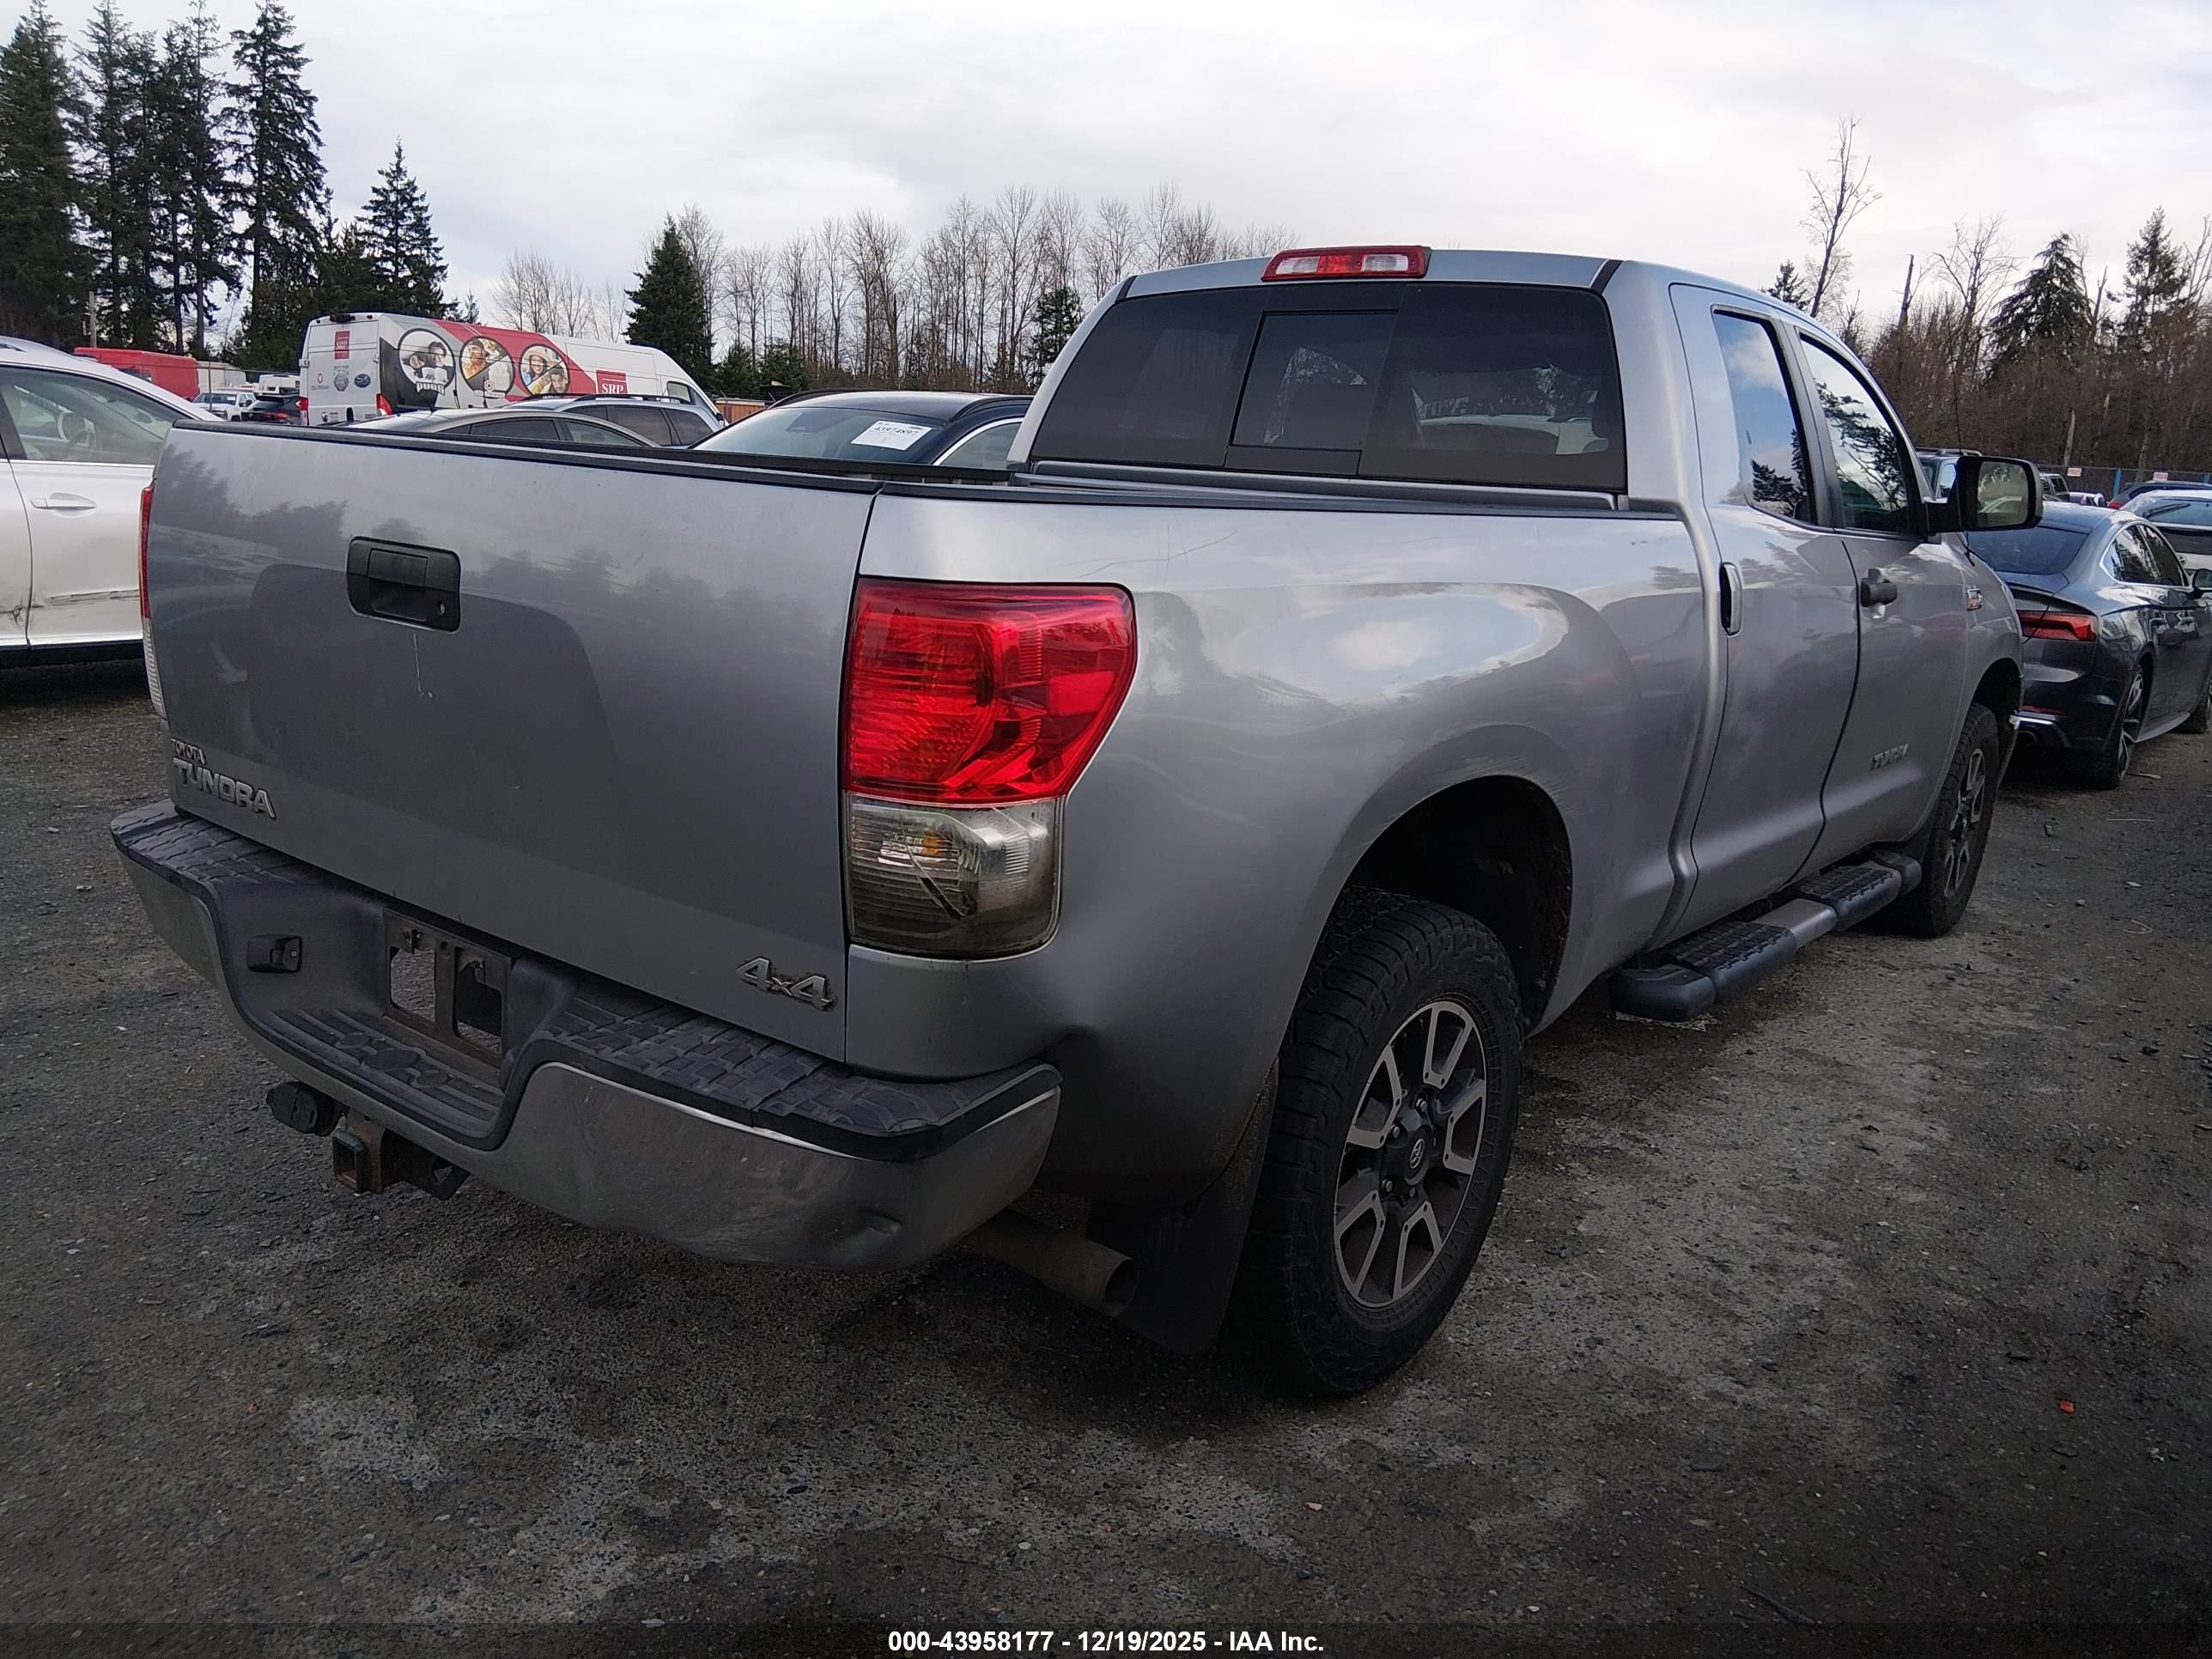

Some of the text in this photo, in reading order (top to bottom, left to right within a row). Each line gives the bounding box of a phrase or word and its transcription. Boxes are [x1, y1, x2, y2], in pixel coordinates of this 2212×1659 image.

[601, 382, 624, 394] SRP
[171, 738, 206, 764] TOYOTA
[173, 757, 276, 818] TUNDRA
[736, 957, 833, 1012] 4x4
